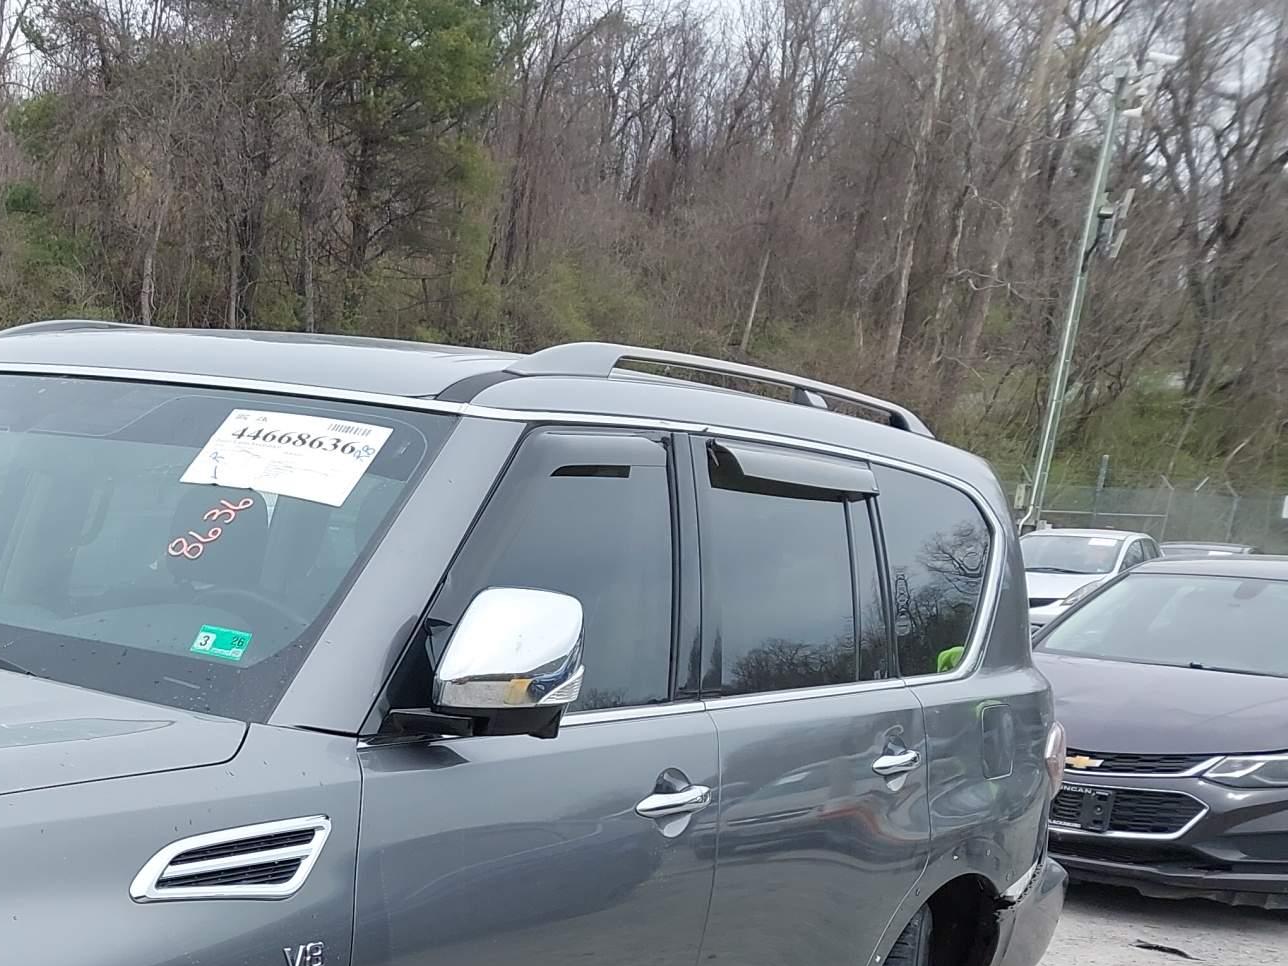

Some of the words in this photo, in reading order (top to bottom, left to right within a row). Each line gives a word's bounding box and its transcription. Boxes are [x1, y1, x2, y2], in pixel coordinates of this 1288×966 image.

[231, 426, 361, 455] 44668636
[167, 497, 254, 560] 8636
[199, 635, 211, 647] 3
